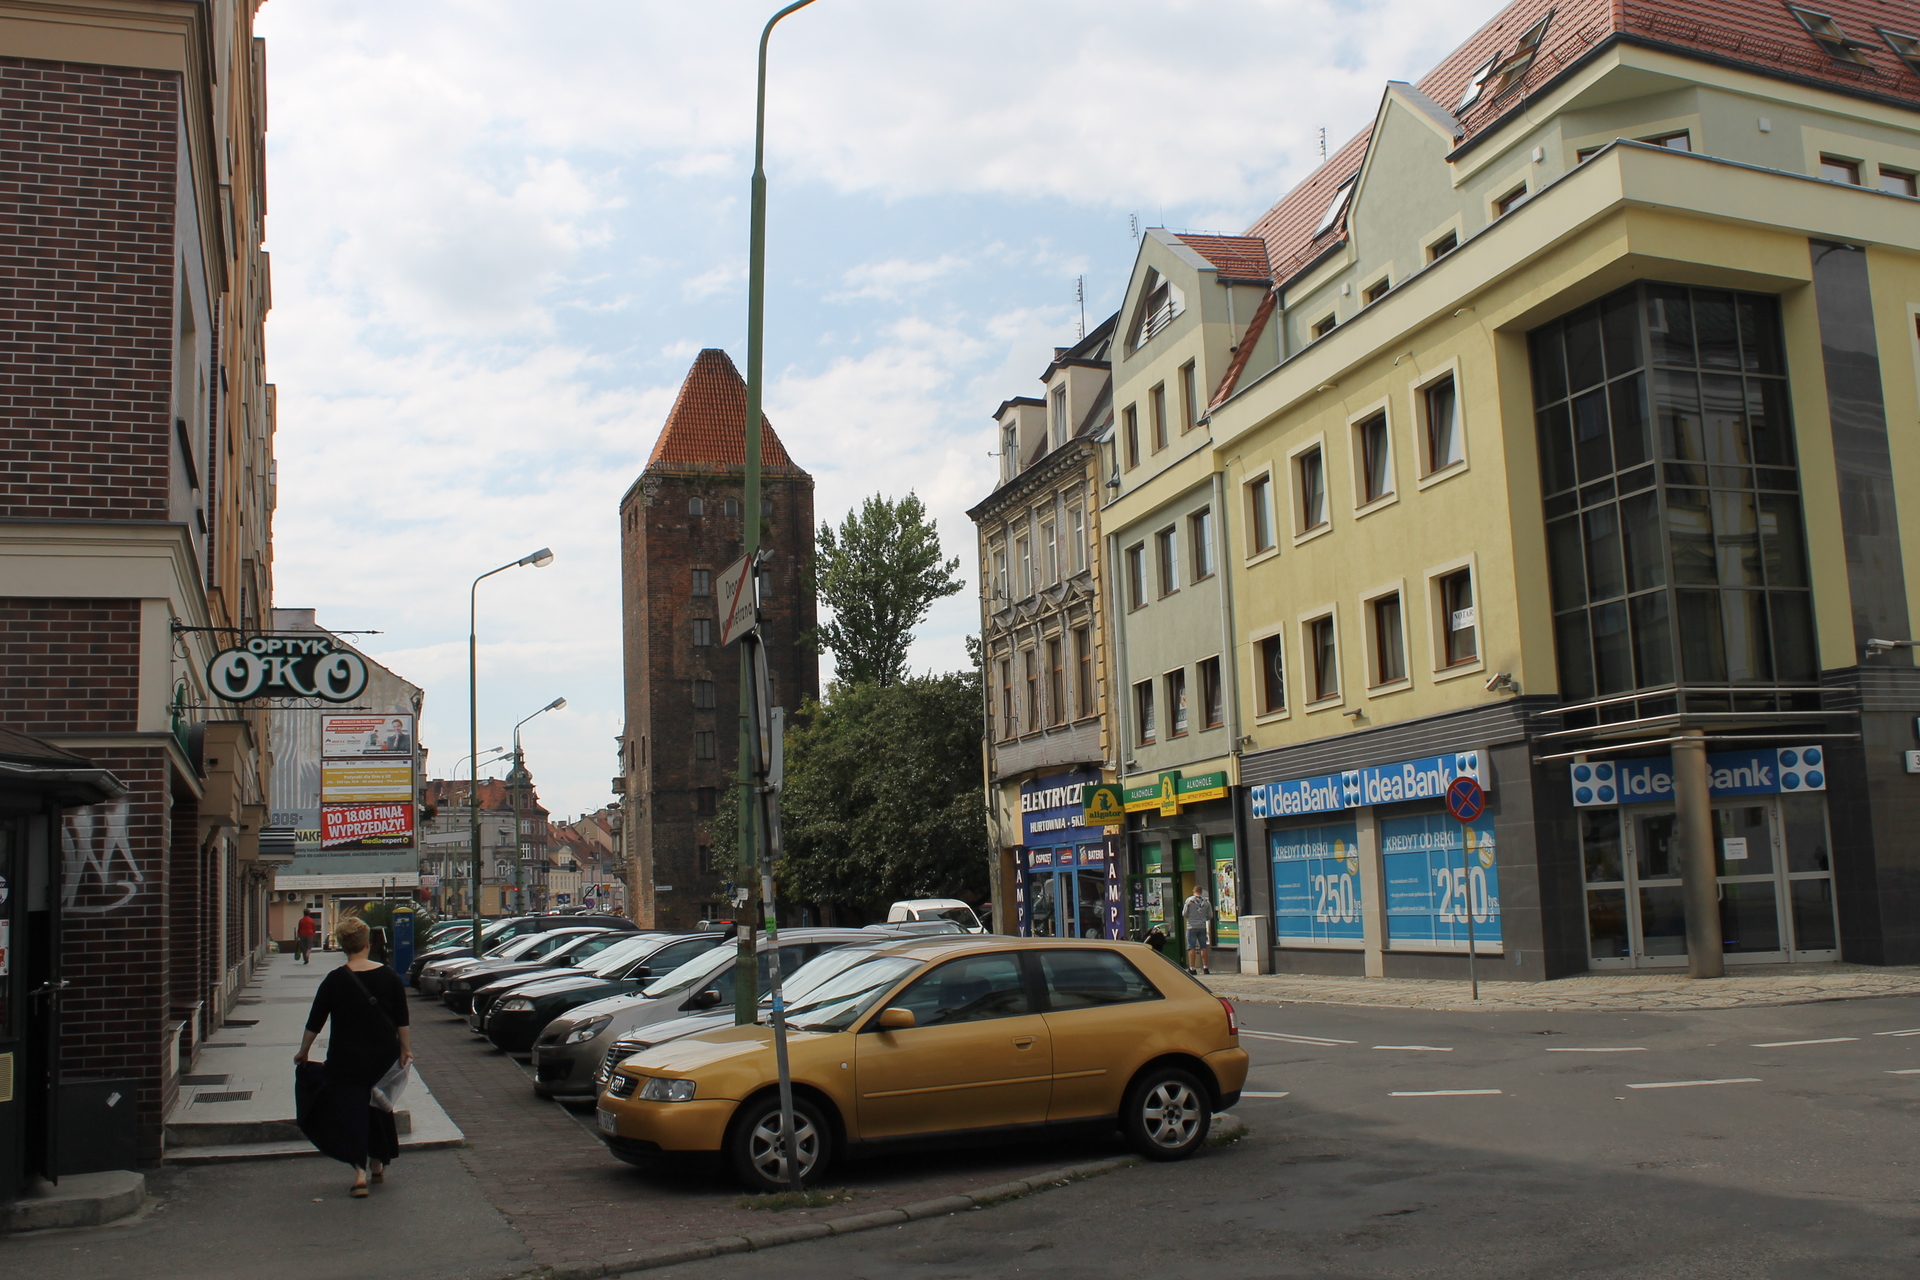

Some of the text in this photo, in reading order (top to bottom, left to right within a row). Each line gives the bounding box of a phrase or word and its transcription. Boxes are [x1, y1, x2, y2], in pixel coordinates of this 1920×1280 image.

[247, 638, 329, 655] OPTYK
[210, 650, 365, 699] OKO
[1186, 777, 1212, 789] ALKOHOLE
[1021, 780, 1098, 812] ELEKTRYCZ
[1131, 788, 1153, 799] ALKOHOLE
[327, 806, 404, 825] DO 18.08 FINAŁ
[1030, 815, 1086, 833] HURTOWNIA SKL
[1089, 810, 1122, 819] aligator
[328, 818, 406, 838] WYPRZEDAŻY!
[1386, 834, 1418, 851] KREDYT
[1420, 833, 1432, 849] OD
[1434, 831, 1454, 851] RĘKI
[1088, 849, 1104, 861] BATERIE
[1275, 845, 1300, 860] KREDYT
[1301, 844, 1311, 858] OD
[1313, 842, 1328, 860] RĘKI
[1015, 850, 1025, 938] LAMPY
[1108, 841, 1119, 940] LAMPY
[1315, 873, 1354, 924] 250
[1437, 866, 1487, 924] 250
